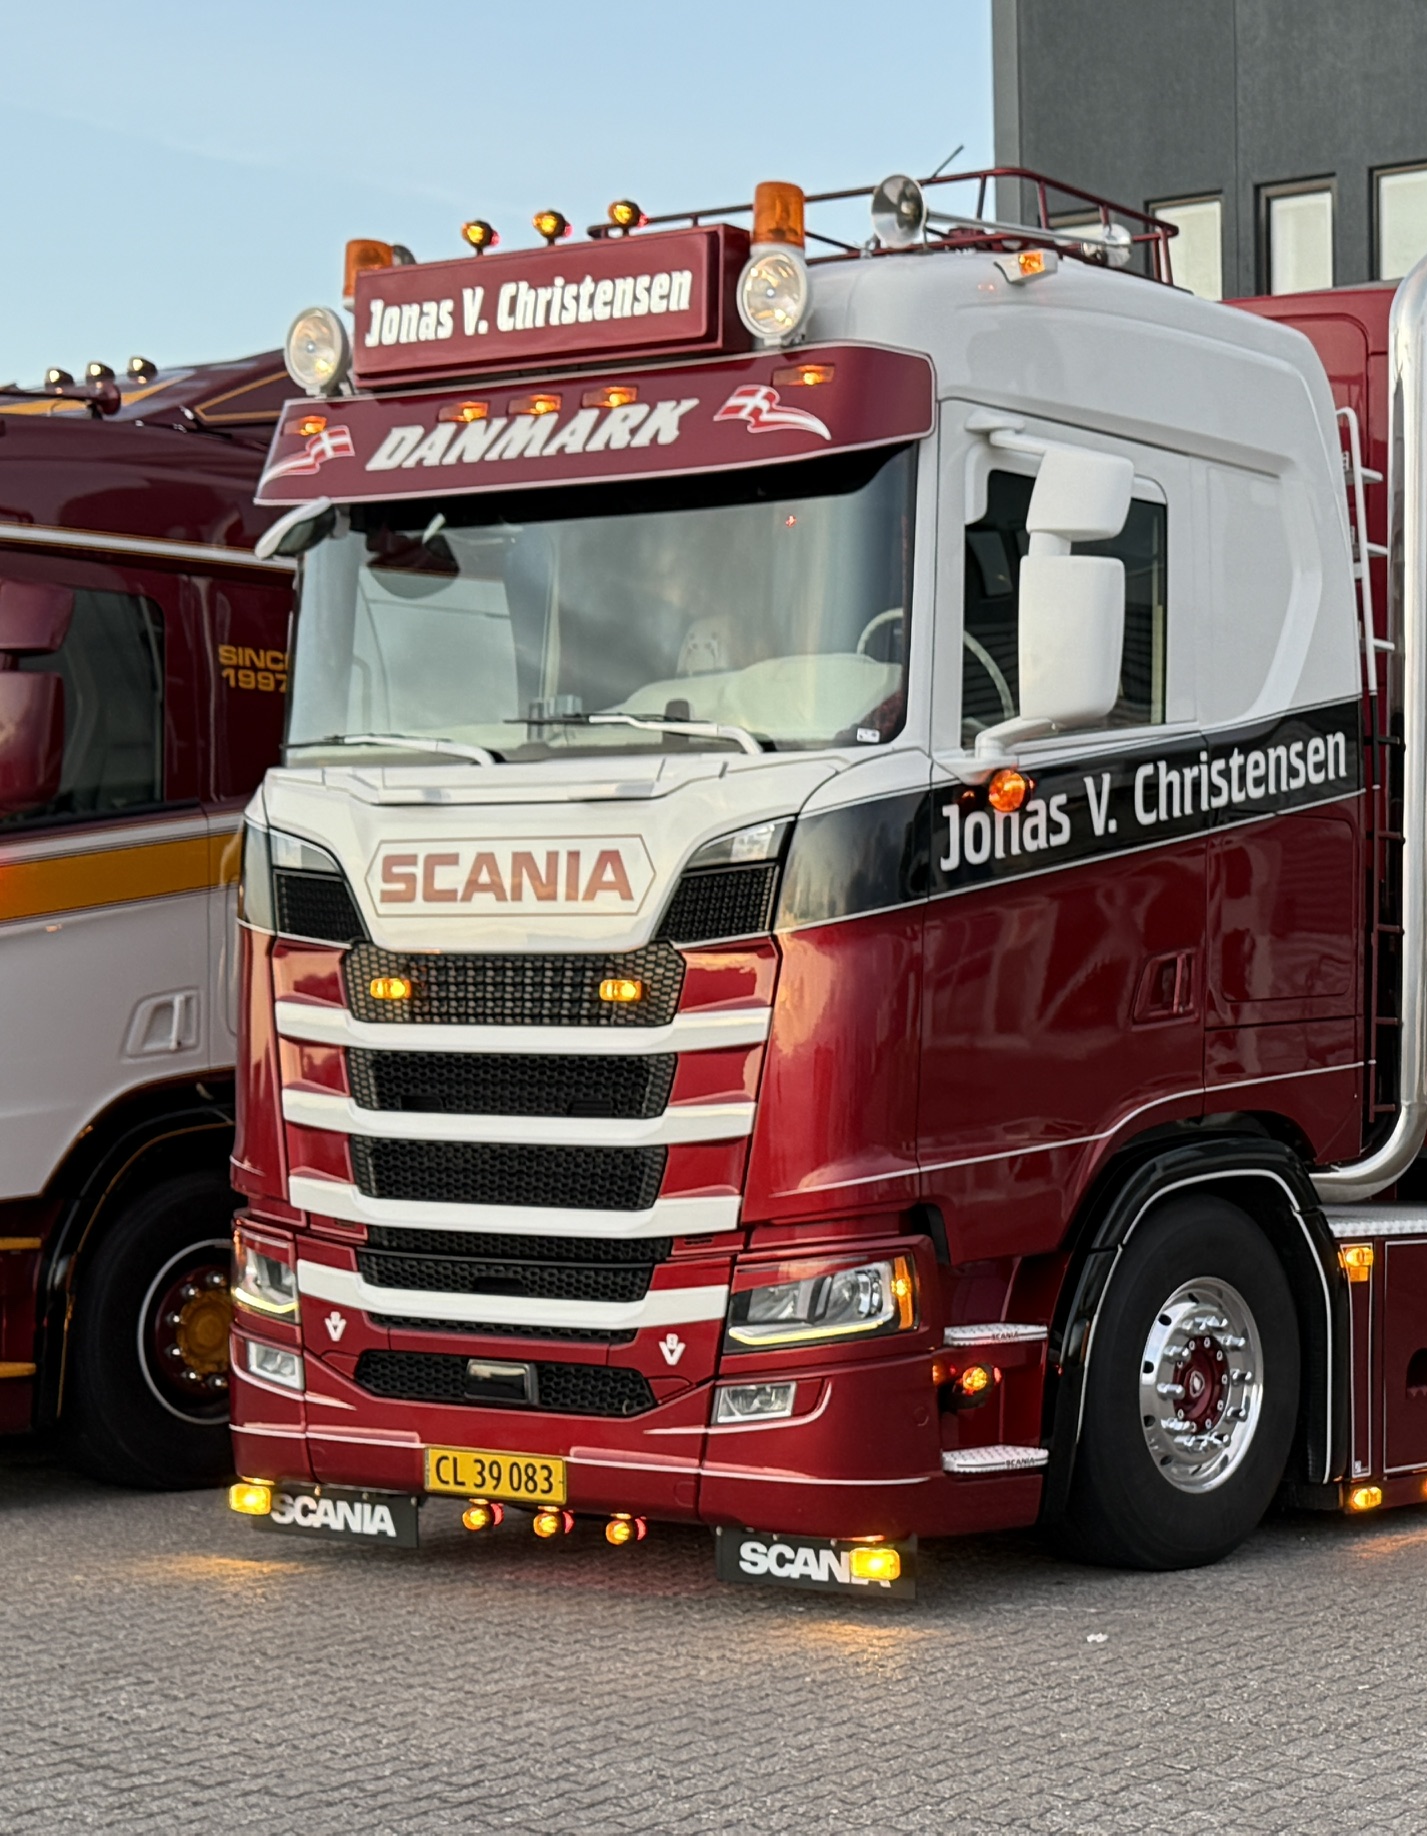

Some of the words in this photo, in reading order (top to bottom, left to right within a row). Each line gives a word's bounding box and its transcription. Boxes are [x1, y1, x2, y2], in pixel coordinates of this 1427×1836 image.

[365, 299, 454, 347] Jonas
[462, 286, 489, 336] V.
[497, 270, 693, 332] Christensen
[365, 398, 699, 471] DANMARK
[222, 668, 287, 693] 1997
[941, 792, 1071, 871] Jonas
[1084, 773, 1117, 836] V.
[1134, 731, 1347, 826] Christensen
[380, 849, 634, 903] SCANIA
[991, 1331, 1019, 1341] SCANIA
[436, 1456, 466, 1486] CL
[473, 1459, 502, 1491] 39
[509, 1462, 553, 1494] 083
[1006, 1457, 1034, 1467] SCANIA
[270, 1493, 397, 1538] SCANIA
[739, 1541, 891, 1588] SCAN
